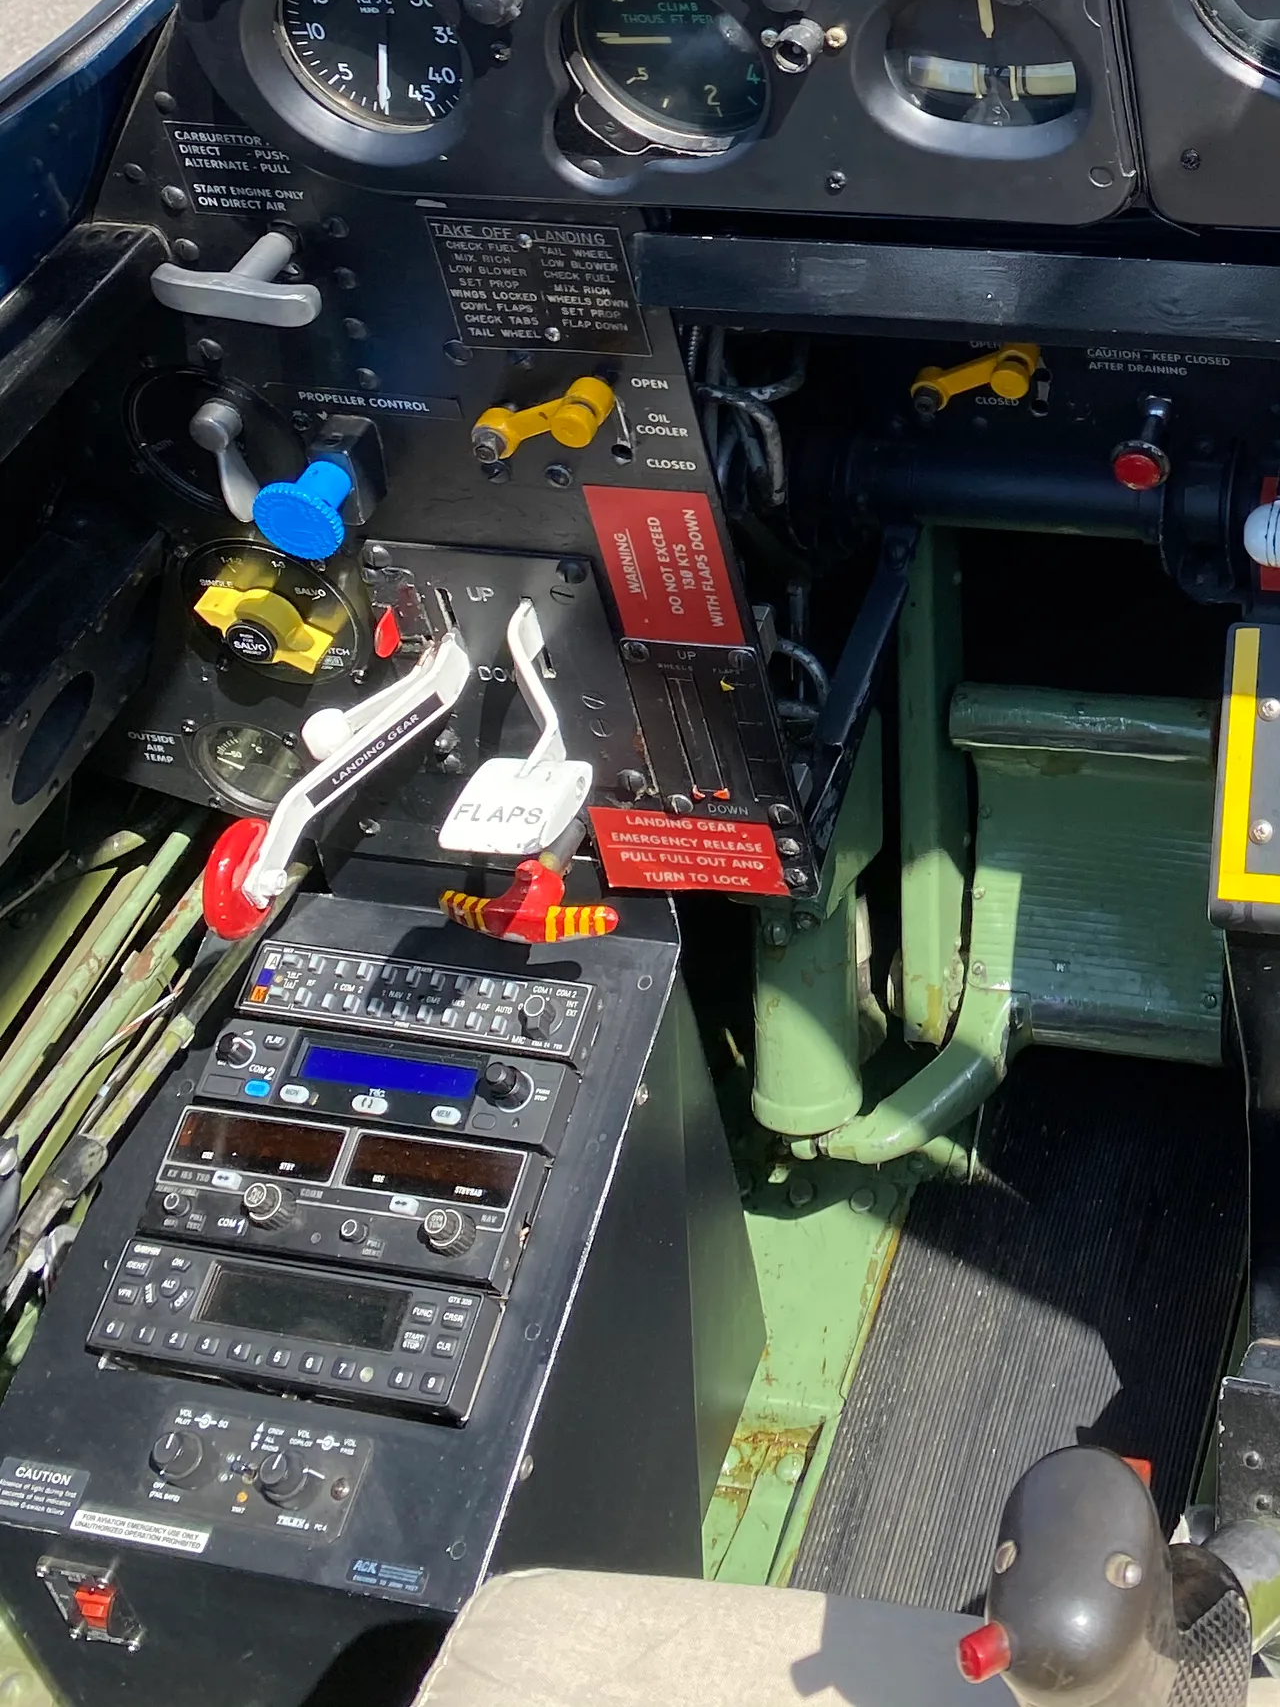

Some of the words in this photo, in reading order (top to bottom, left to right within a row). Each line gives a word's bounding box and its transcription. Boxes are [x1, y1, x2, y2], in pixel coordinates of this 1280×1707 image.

[179, 145, 220, 156] DIRECT
[255, 150, 290, 161] PUSH
[185, 158, 250, 171] ALTERNATE
[260, 163, 291, 174] PULL
[193, 183, 227, 195] START
[231, 186, 272, 198] ENGINE
[275, 189, 304, 200] ONLY
[198, 196, 218, 207] ON
[221, 198, 261, 210] DIRECT
[266, 201, 286, 212] AIR
[430, 223, 473, 236] TAKE
[482, 227, 512, 239] OFF
[533, 230, 605, 245] LANDING
[1087, 348, 1141, 360] CAUTION
[1152, 352, 1181, 363] KEEP
[1185, 354, 1231, 366] CLOSED
[1089, 362, 1124, 372] AFTER
[1127, 364, 1187, 376] DRAINING
[631, 378, 669, 390] OPEN
[299, 391, 366, 408] PROPELLER
[369, 396, 430, 413] CONTROL
[975, 396, 1020, 407] CLOSED
[649, 412, 671, 424] OIL
[636, 423, 689, 438] COOLER
[646, 457, 696, 472] CLOSED
[682, 509, 705, 552] DOWN
[647, 516, 670, 563] EXCEED
[614, 533, 642, 594] WARNING
[672, 544, 691, 567] KTS
[660, 566, 678, 593] NOT
[695, 555, 718, 592] FLAPS
[466, 586, 494, 602] UP
[669, 595, 684, 615] DO
[706, 595, 725, 628] WITH
[677, 650, 697, 661] UP
[128, 731, 175, 745] OUTSIDE
[146, 744, 165, 753] AIR
[331, 742, 386, 786] LANDING
[386, 713, 420, 743] GEAR
[144, 752, 174, 764] TEMP
[452, 803, 544, 824] FLAPS
[707, 804, 749, 816] DOWN
[626, 816, 692, 831] LANDING
[697, 820, 736, 834] GEAR
[611, 832, 698, 848] EMERGENCY
[702, 839, 763, 854] RELEASE
[620, 851, 657, 864] PULL
[660, 853, 693, 866] FULL
[696, 856, 728, 867] OUT
[731, 859, 764, 870] AND
[643, 871, 684, 883] TURN
[688, 873, 708, 884] TO
[711, 873, 751, 887] LOCK
[15, 1466, 72, 1486] CAUTION
[74, 1520, 123, 1536] UNAUTHORIZED
[124, 1529, 161, 1542] OPERATION
[162, 1536, 201, 1550] PROHIBITED
[82, 1513, 96, 1521] FOR
[97, 1515, 125, 1527] AVIATION
[127, 1520, 166, 1535] EMERGENCY
[167, 1528, 181, 1536] USE
[182, 1531, 200, 1541] ONLY
